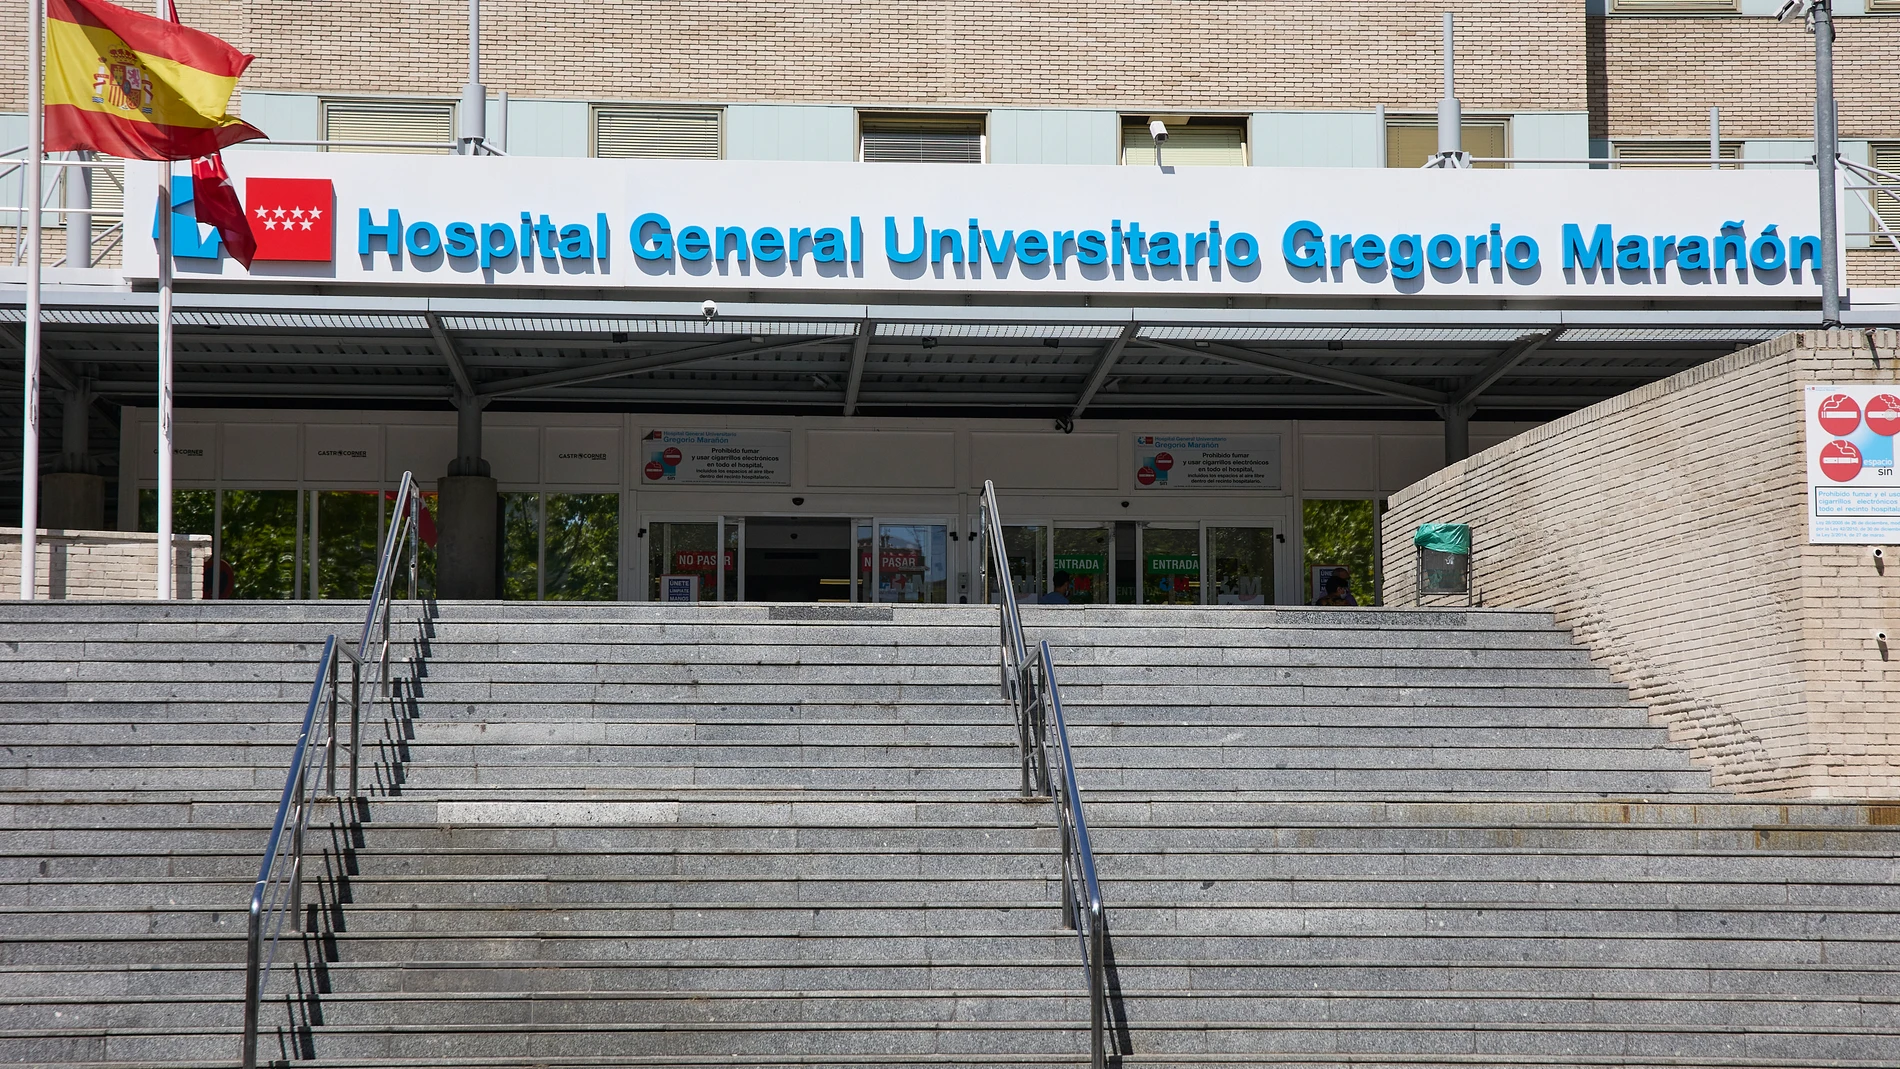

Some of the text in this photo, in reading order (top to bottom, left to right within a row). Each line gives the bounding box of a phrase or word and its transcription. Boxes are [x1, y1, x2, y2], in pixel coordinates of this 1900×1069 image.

[358, 208, 1822, 280] Hospital General Universitario Gregorio Marañón
[1863, 458, 1892, 467] espacio
[1878, 466, 1892, 476] sin
[680, 555, 731, 565] NO PASR
[883, 558, 916, 567] PASAR
[1054, 559, 1099, 569] ENTRADA
[1153, 560, 1199, 570] ENTRADA
